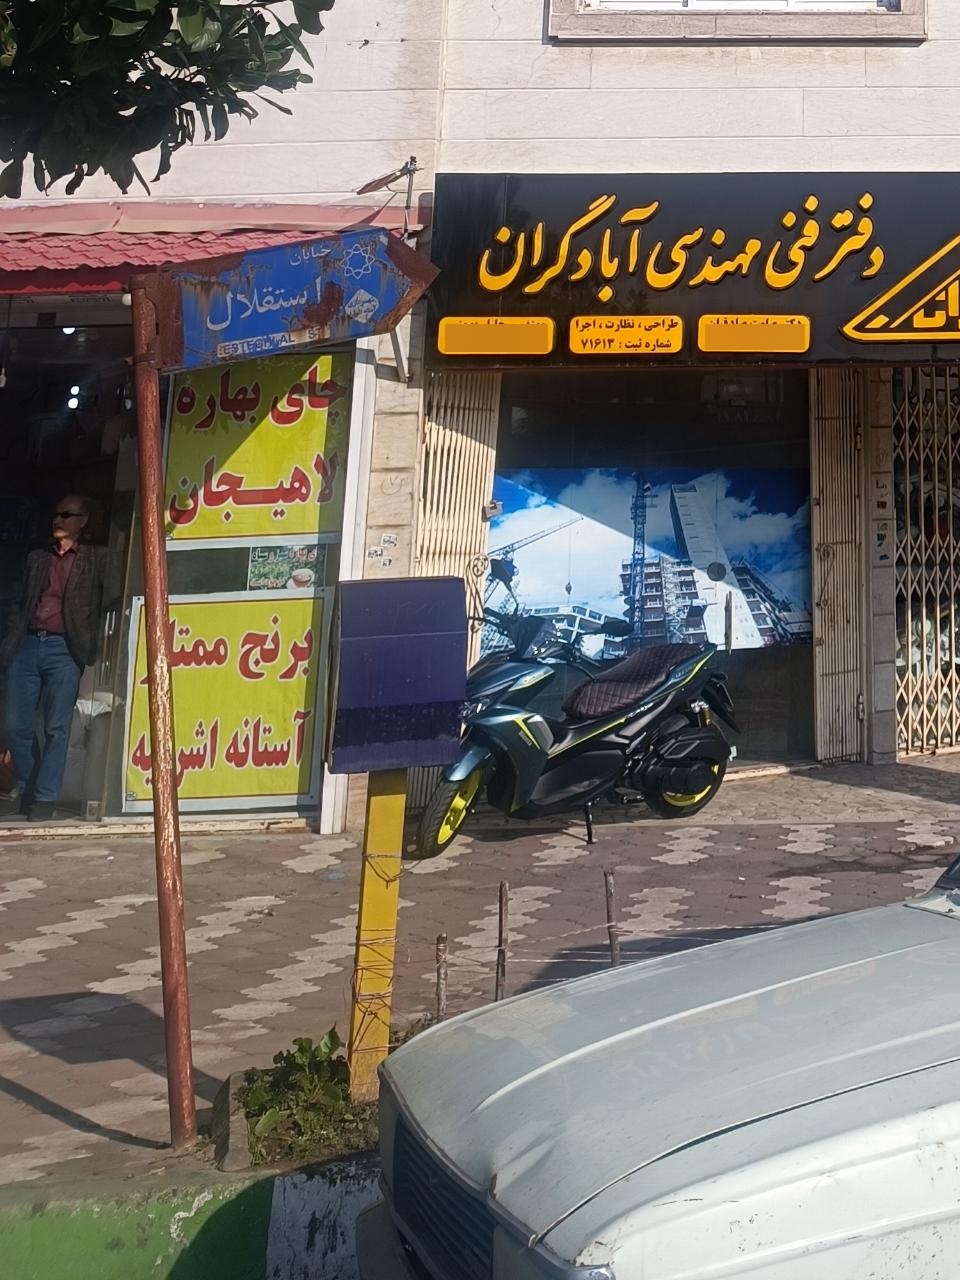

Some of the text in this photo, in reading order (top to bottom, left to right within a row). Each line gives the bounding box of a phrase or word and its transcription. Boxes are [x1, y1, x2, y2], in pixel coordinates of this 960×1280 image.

[289, 244, 332, 266] خیابان
[477, 192, 886, 303] دفتر فنی مهندسی آبادگران
[206, 275, 322, 332] استقلال
[575, 319, 596, 333] اجرا
[644, 338, 672, 352] شماره
[175, 365, 348, 430] چای بهاره
[168, 451, 340, 526] لاهیجان
[139, 614, 314, 686] برنج ممتا
[225, 709, 313, 769] آستانه
